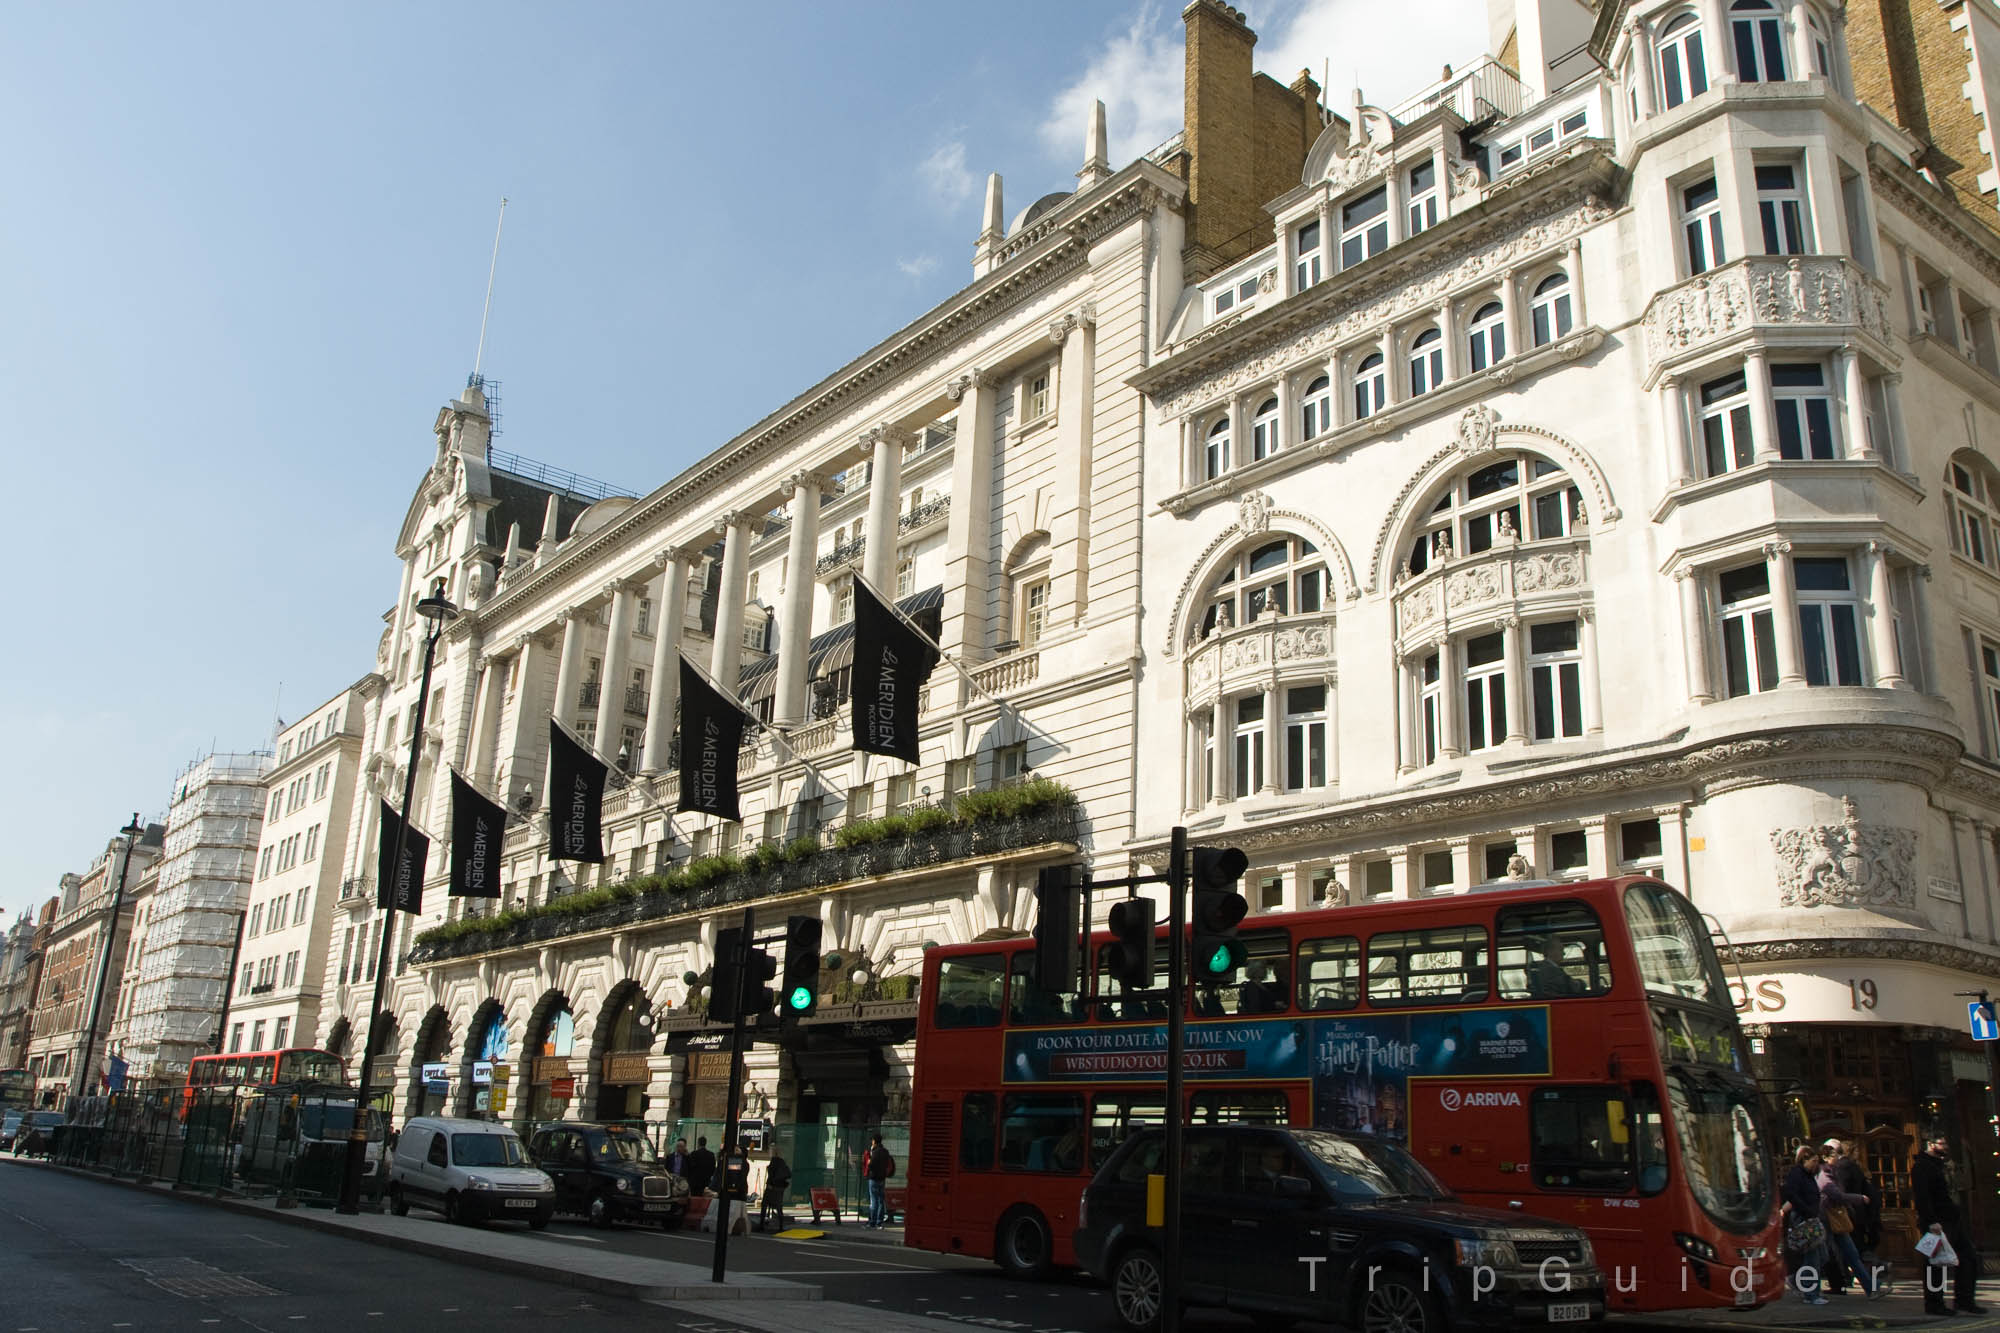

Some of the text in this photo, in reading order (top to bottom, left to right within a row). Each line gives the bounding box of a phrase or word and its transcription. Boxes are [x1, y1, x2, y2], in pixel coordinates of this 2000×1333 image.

[879, 645, 898, 749] Le MERIDIEN
[868, 704, 877, 745] PICCADILLY
[702, 716, 720, 809] Le MERIDIEN
[571, 774, 588, 855] Le MERIDIEN
[398, 858, 413, 906] MERIDIEN
[472, 832, 488, 889] MERIDIEN
[1849, 978, 1878, 1010] 19
[1036, 1028, 1265, 1050] BOOK YOUR DATE AN TIME NOW
[1317, 1035, 1421, 1081] Harry Potter
[1479, 1046, 1506, 1054] STUDIO
[1464, 1091, 1522, 1106] ARRIVA
[1603, 1198, 1619, 1207] DW
